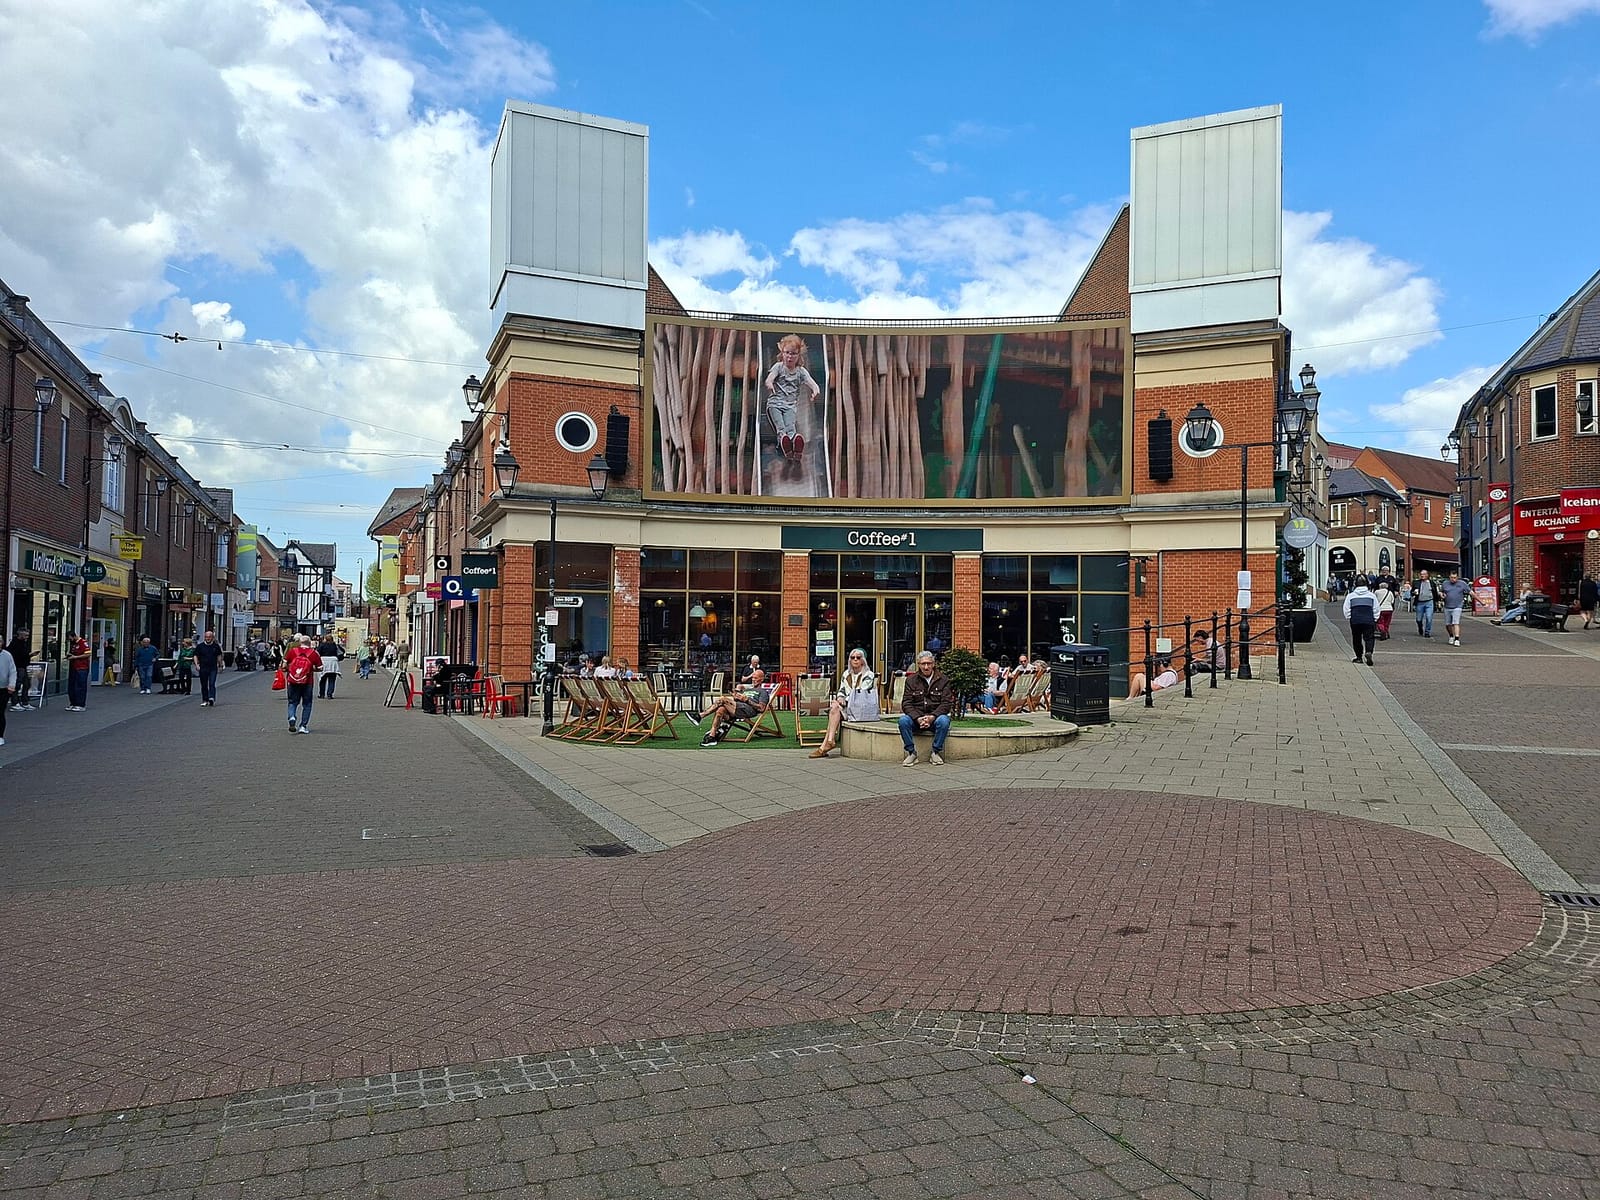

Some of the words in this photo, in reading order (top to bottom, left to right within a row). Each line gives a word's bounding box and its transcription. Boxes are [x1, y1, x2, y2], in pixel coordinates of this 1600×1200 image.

[1563, 497, 1600, 507] Icelan
[1533, 516, 1580, 527] EXCHANGE
[847, 530, 917, 546] Coffee#1
[32, 550, 57, 574] Holland
[463, 566, 497, 575] Coffee#1
[446, 580, 463, 596] O2
[170, 591, 181, 599] W
